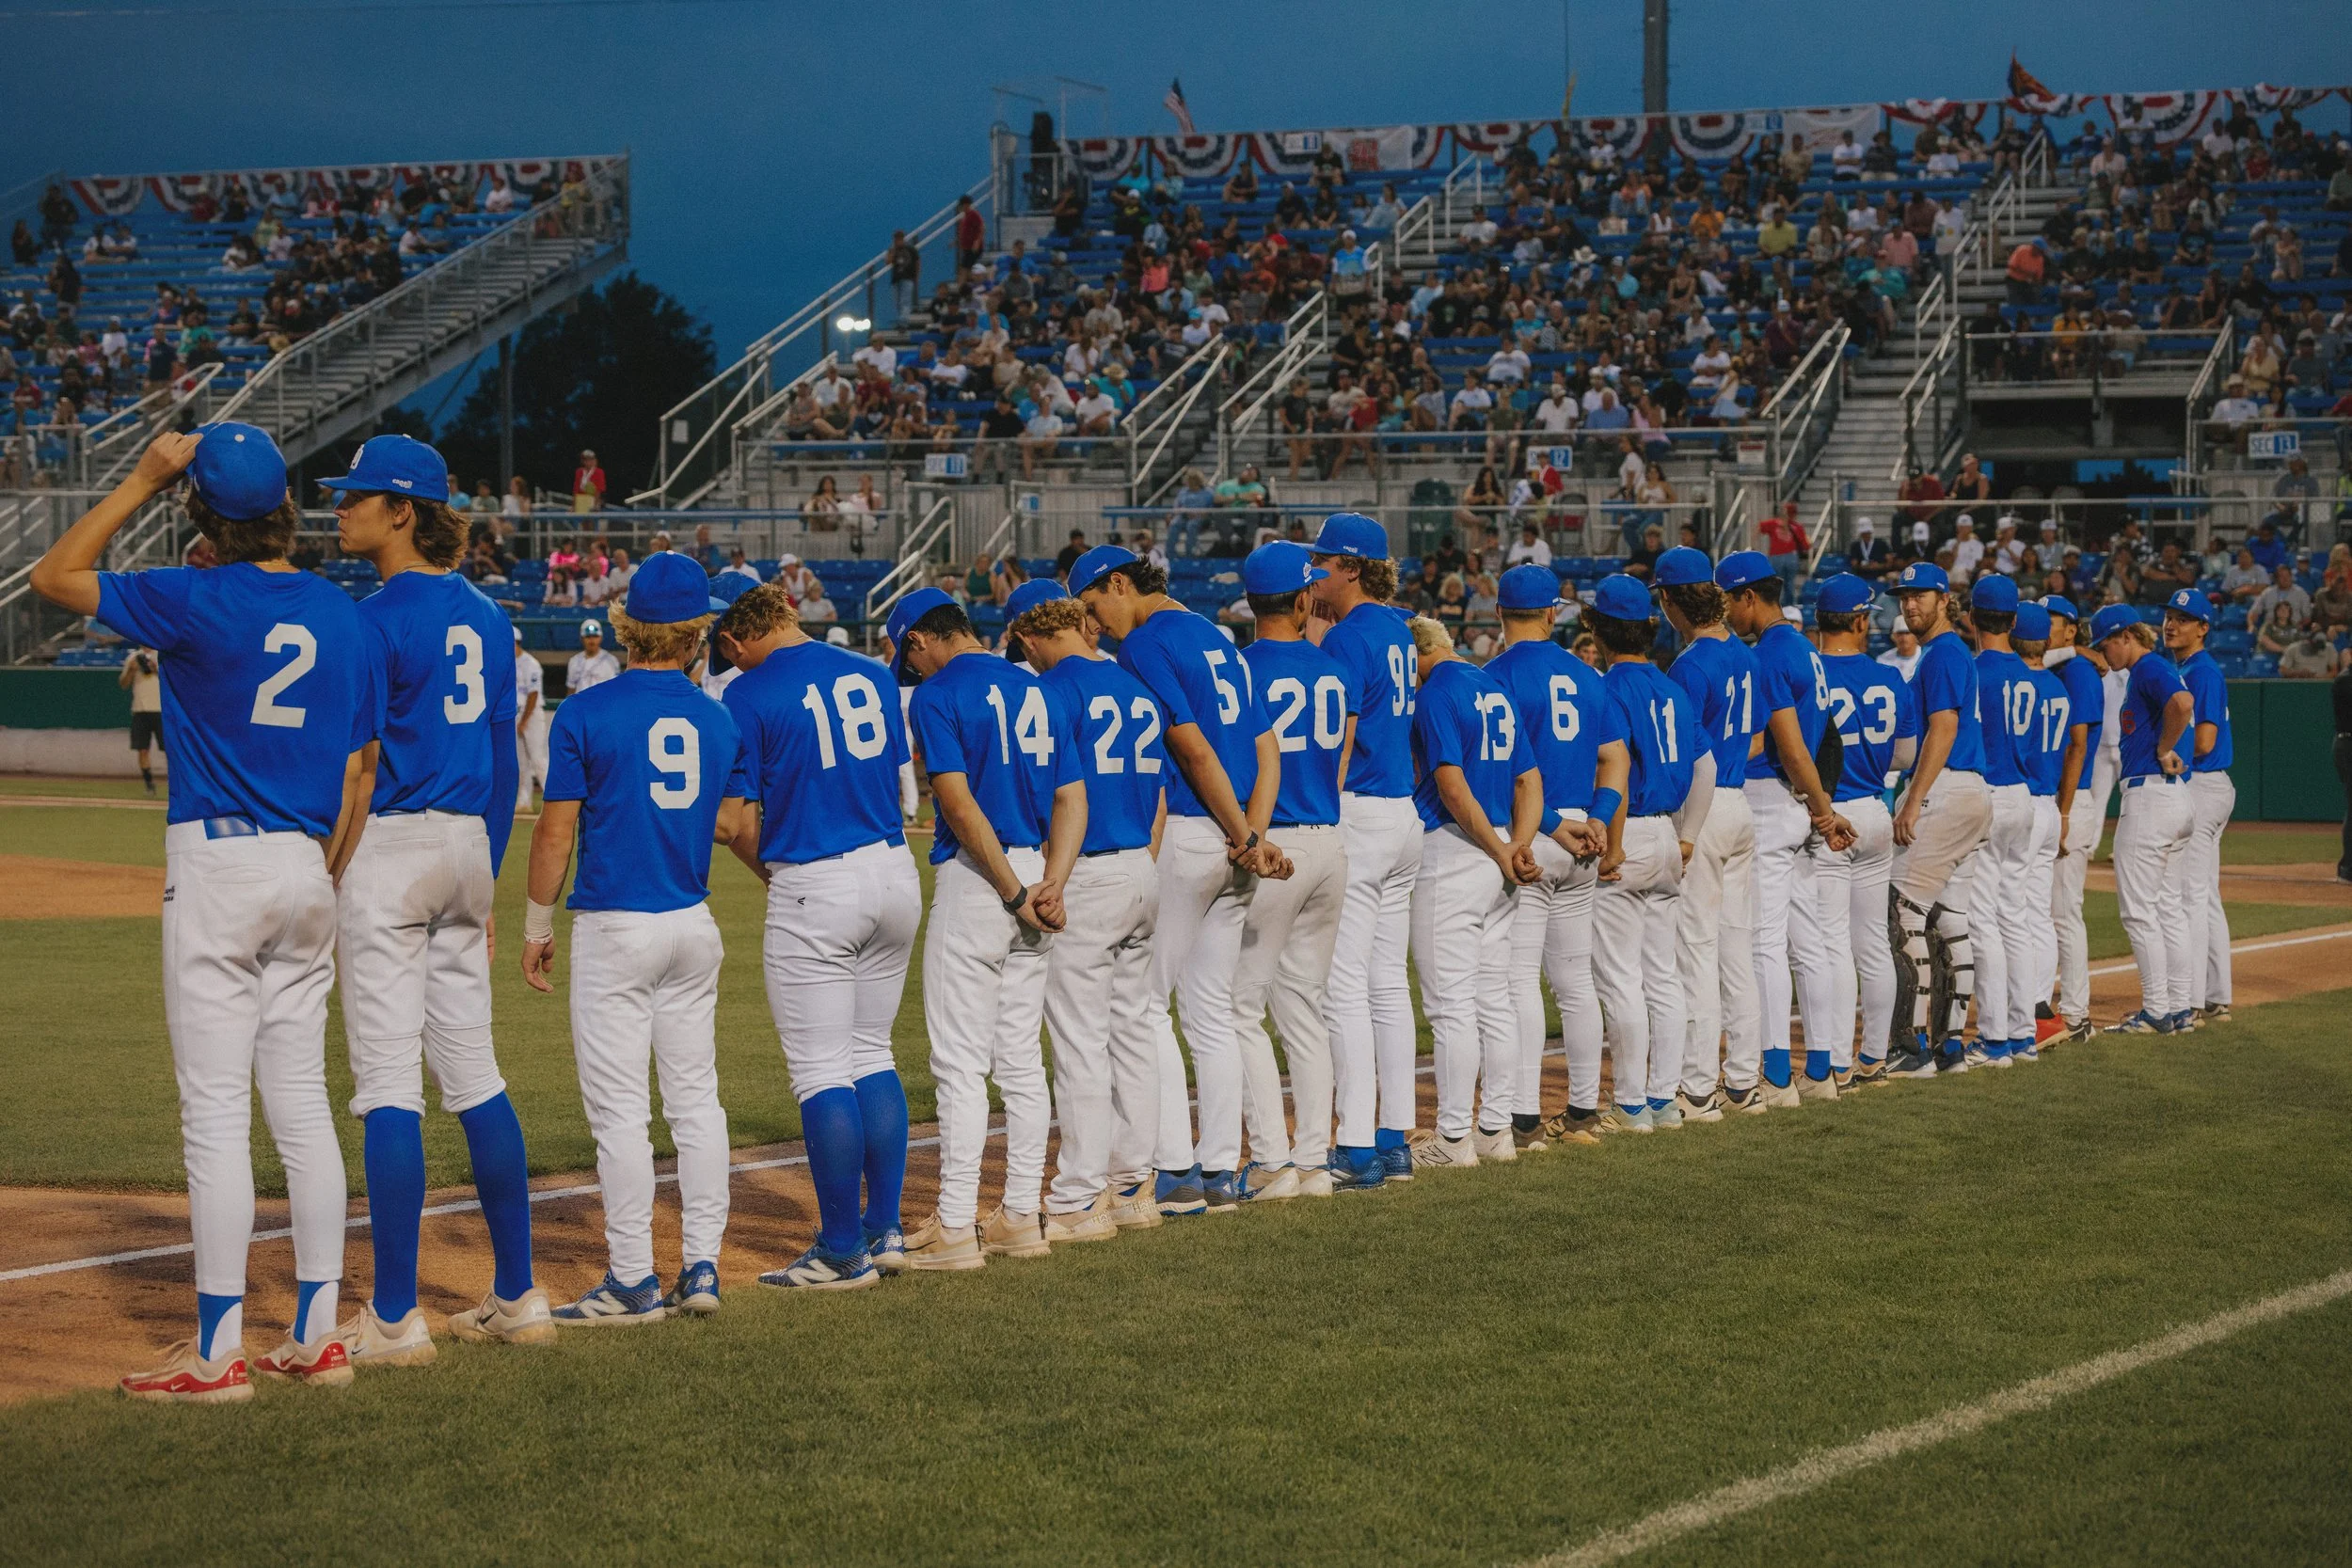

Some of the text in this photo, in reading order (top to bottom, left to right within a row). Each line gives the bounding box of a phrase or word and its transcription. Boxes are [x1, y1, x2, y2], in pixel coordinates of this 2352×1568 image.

[251, 624, 317, 728] 2
[443, 625, 486, 724] 3
[1202, 648, 1252, 725] 51
[1387, 643, 1419, 717] 99
[1549, 674, 1581, 741] 6
[1723, 670, 1753, 741] 21
[1809, 651, 1830, 711] 8
[2002, 680, 2036, 736] 10
[802, 673, 887, 769] 18
[986, 684, 1055, 767] 14
[1089, 695, 1162, 774] 22
[1267, 674, 1346, 753] 20
[1473, 691, 1516, 761] 13
[1649, 697, 1679, 764] 11
[1829, 685, 1897, 747] 23
[2041, 696, 2071, 752] 17
[648, 717, 701, 810] 9
